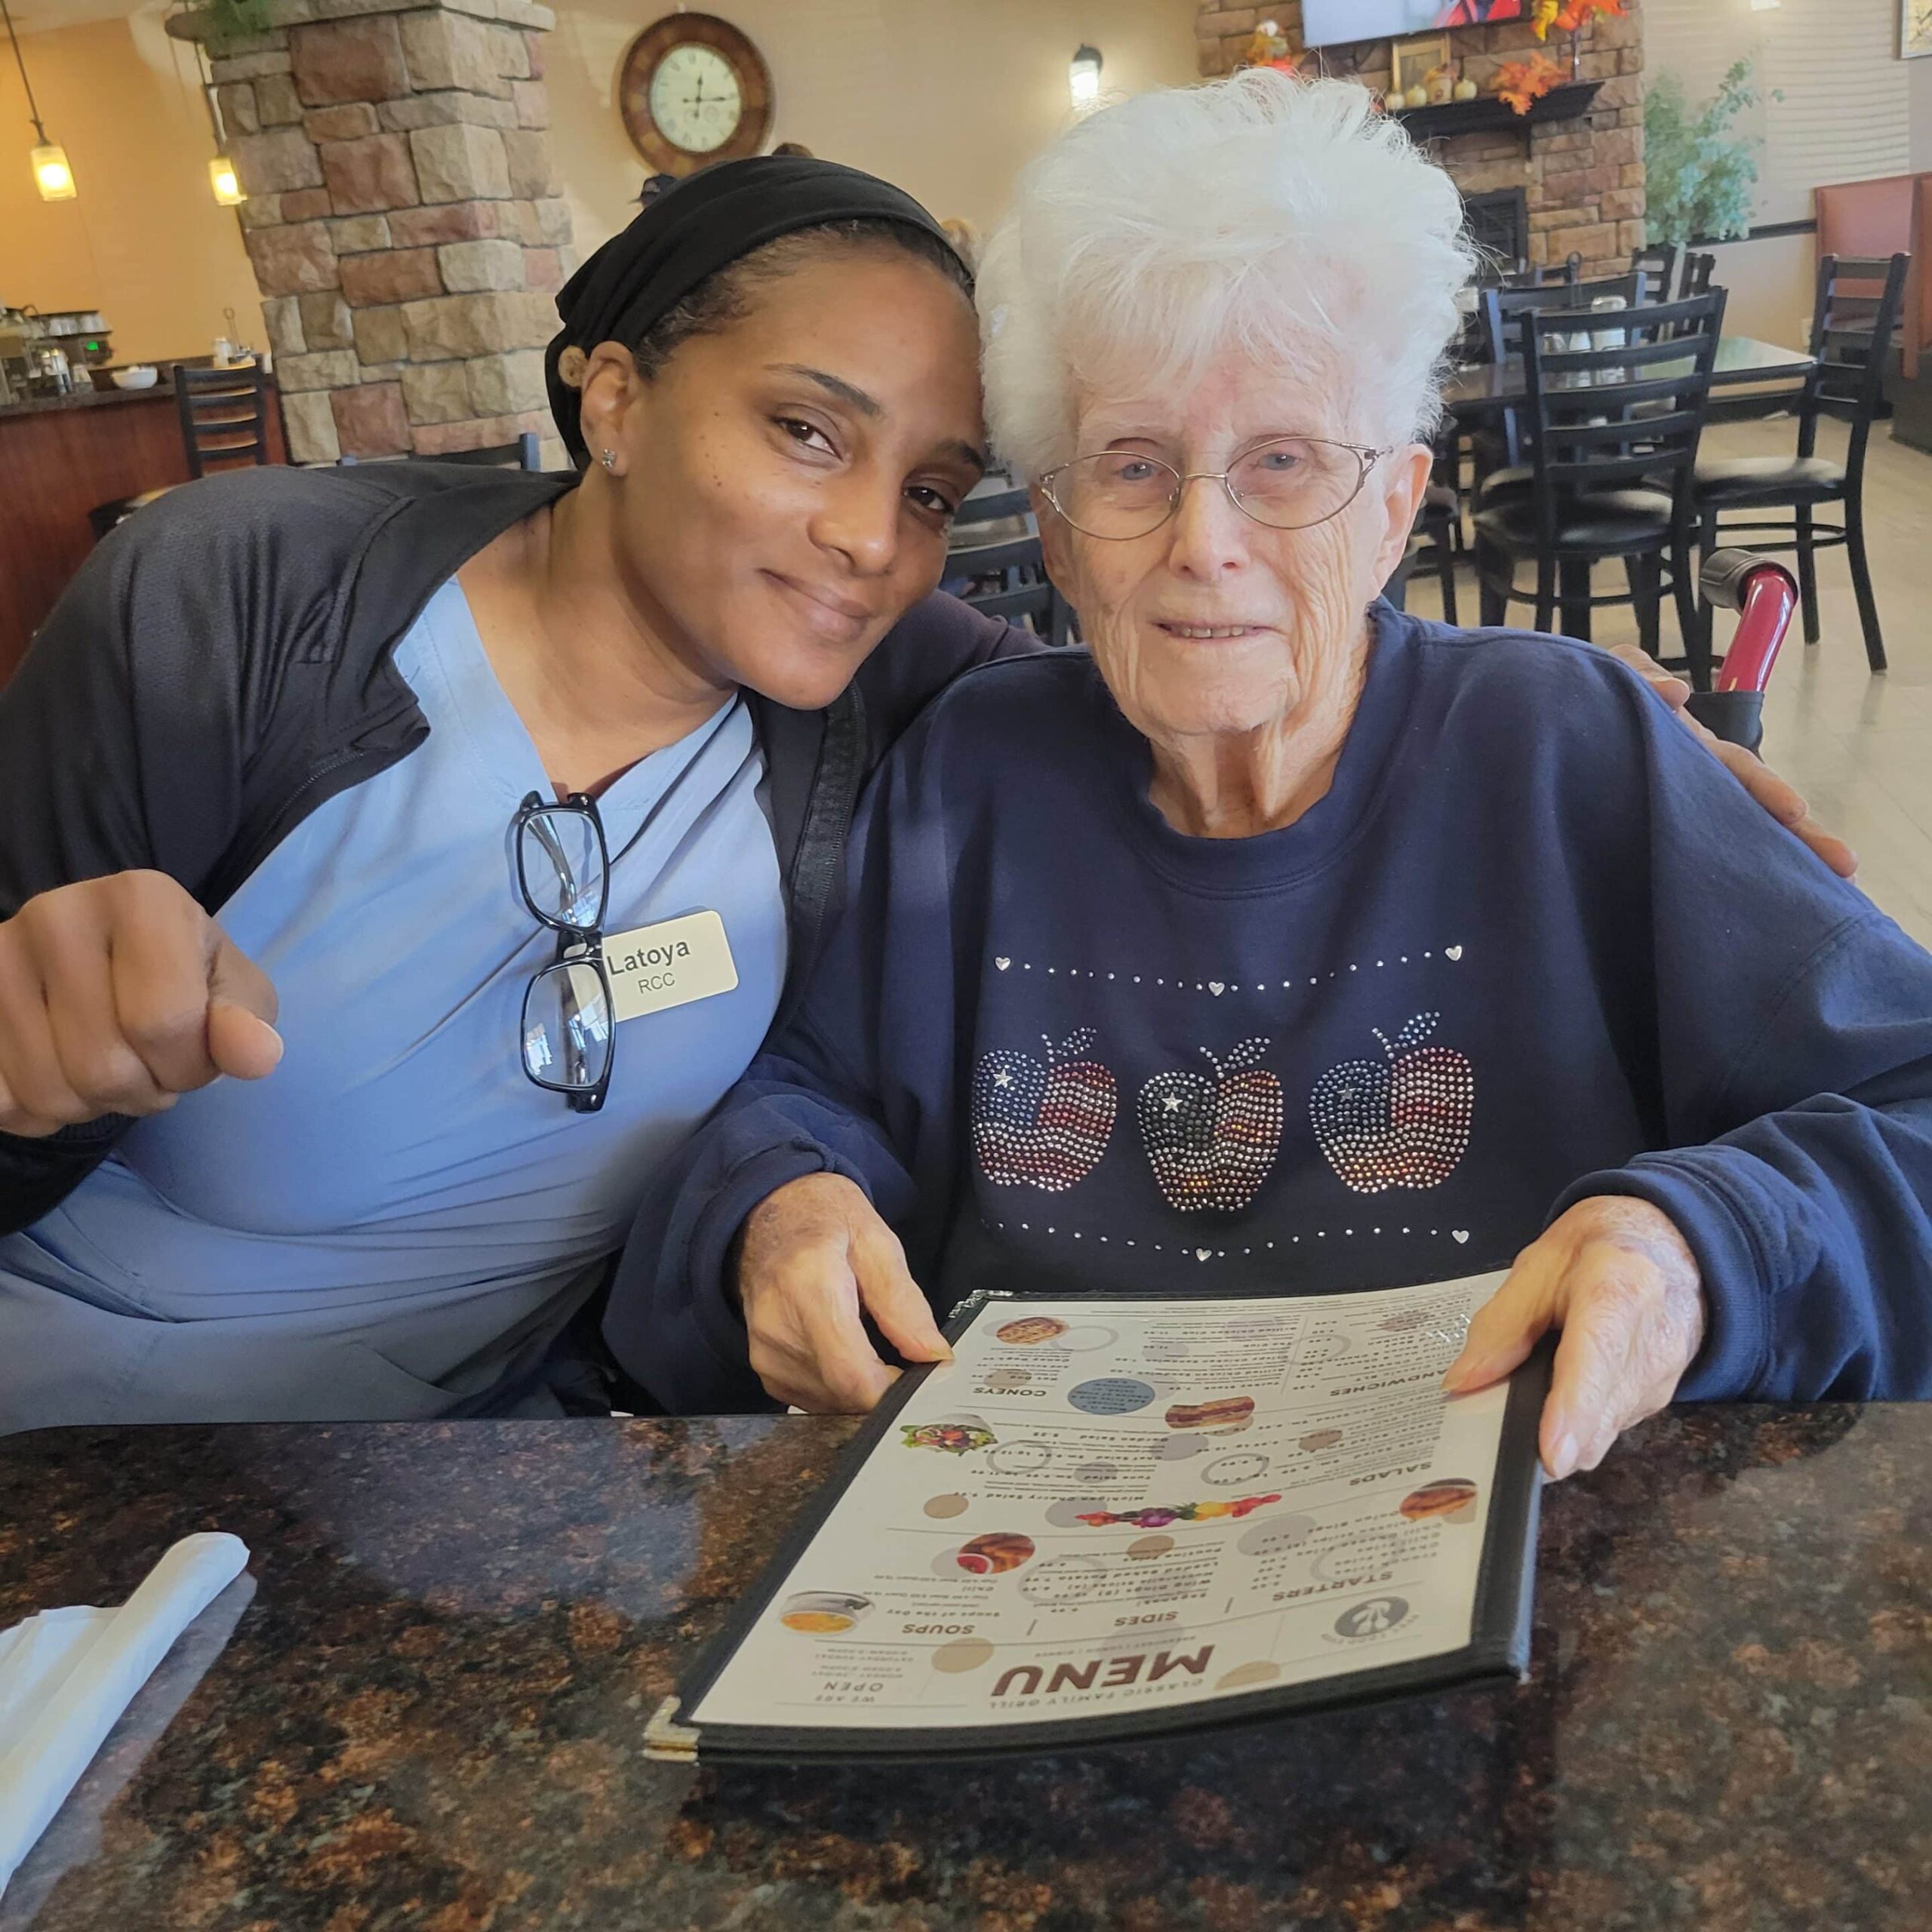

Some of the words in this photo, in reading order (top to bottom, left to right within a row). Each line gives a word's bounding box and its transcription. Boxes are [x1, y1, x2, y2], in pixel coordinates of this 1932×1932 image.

[606, 940, 691, 976] Latoya
[638, 972, 675, 994] RCC
[1330, 1368, 1447, 1396] ANDWICHES
[972, 1386, 1047, 1397] CONEYS
[1349, 1460, 1432, 1487] SALADS
[1029, 1494, 1076, 1502] Cherry
[1112, 1570, 1158, 1578] Baked
[1164, 1561, 1219, 1574] Loaded
[1272, 1571, 1394, 1601] STARTERS
[886, 1608, 910, 1617] Day
[961, 1610, 1000, 1618] Soups
[1113, 1611, 1178, 1626] SIDES
[902, 1623, 976, 1635] SOUPS
[991, 1644, 1215, 1697] MENU
[823, 1681, 884, 1692] OPEN
[1123, 1678, 1203, 1697] CLASSIC
[1048, 1690, 1115, 1704] FAMILY
